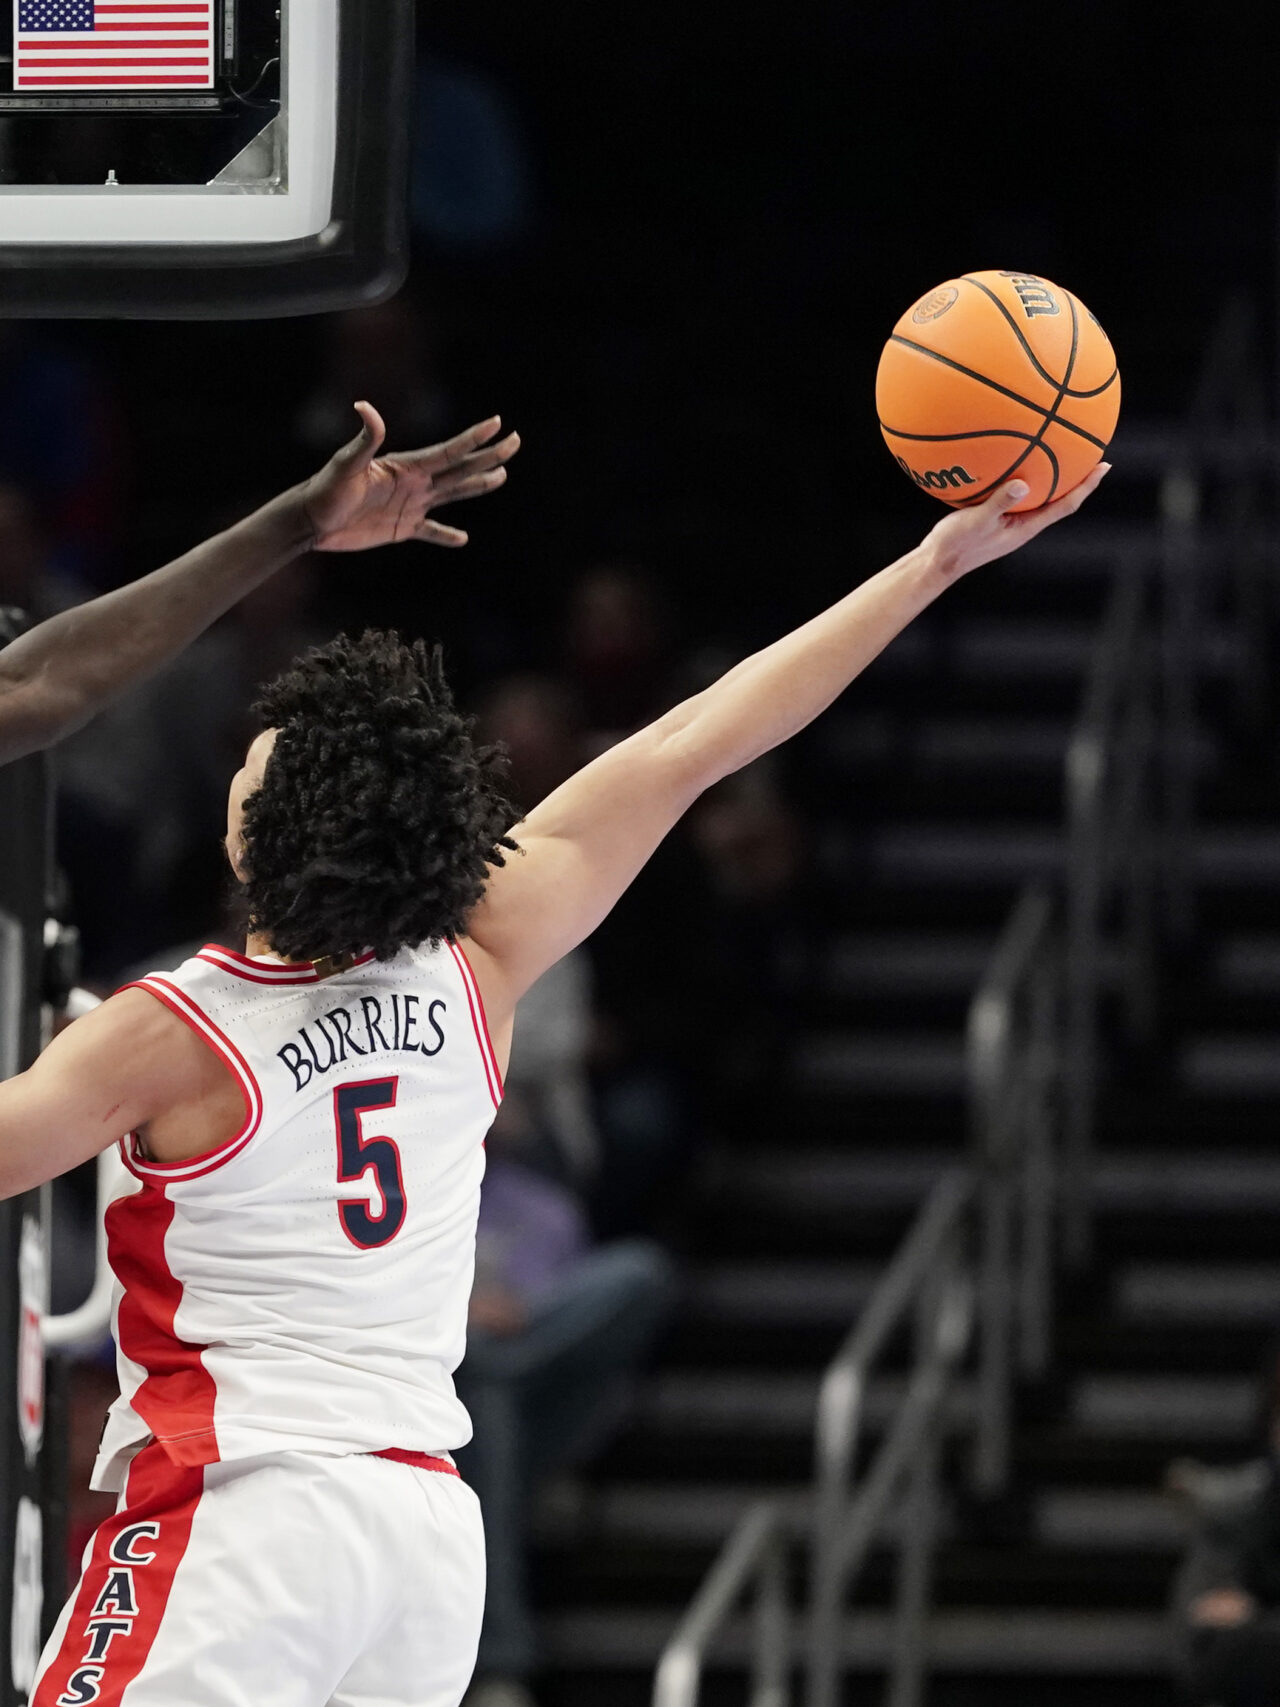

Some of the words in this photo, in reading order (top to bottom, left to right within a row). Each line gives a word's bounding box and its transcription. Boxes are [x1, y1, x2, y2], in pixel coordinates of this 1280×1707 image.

[277, 994, 447, 1092] BURRIES
[333, 1075, 407, 1250] 5
[56, 1521, 160, 1707] CATS
